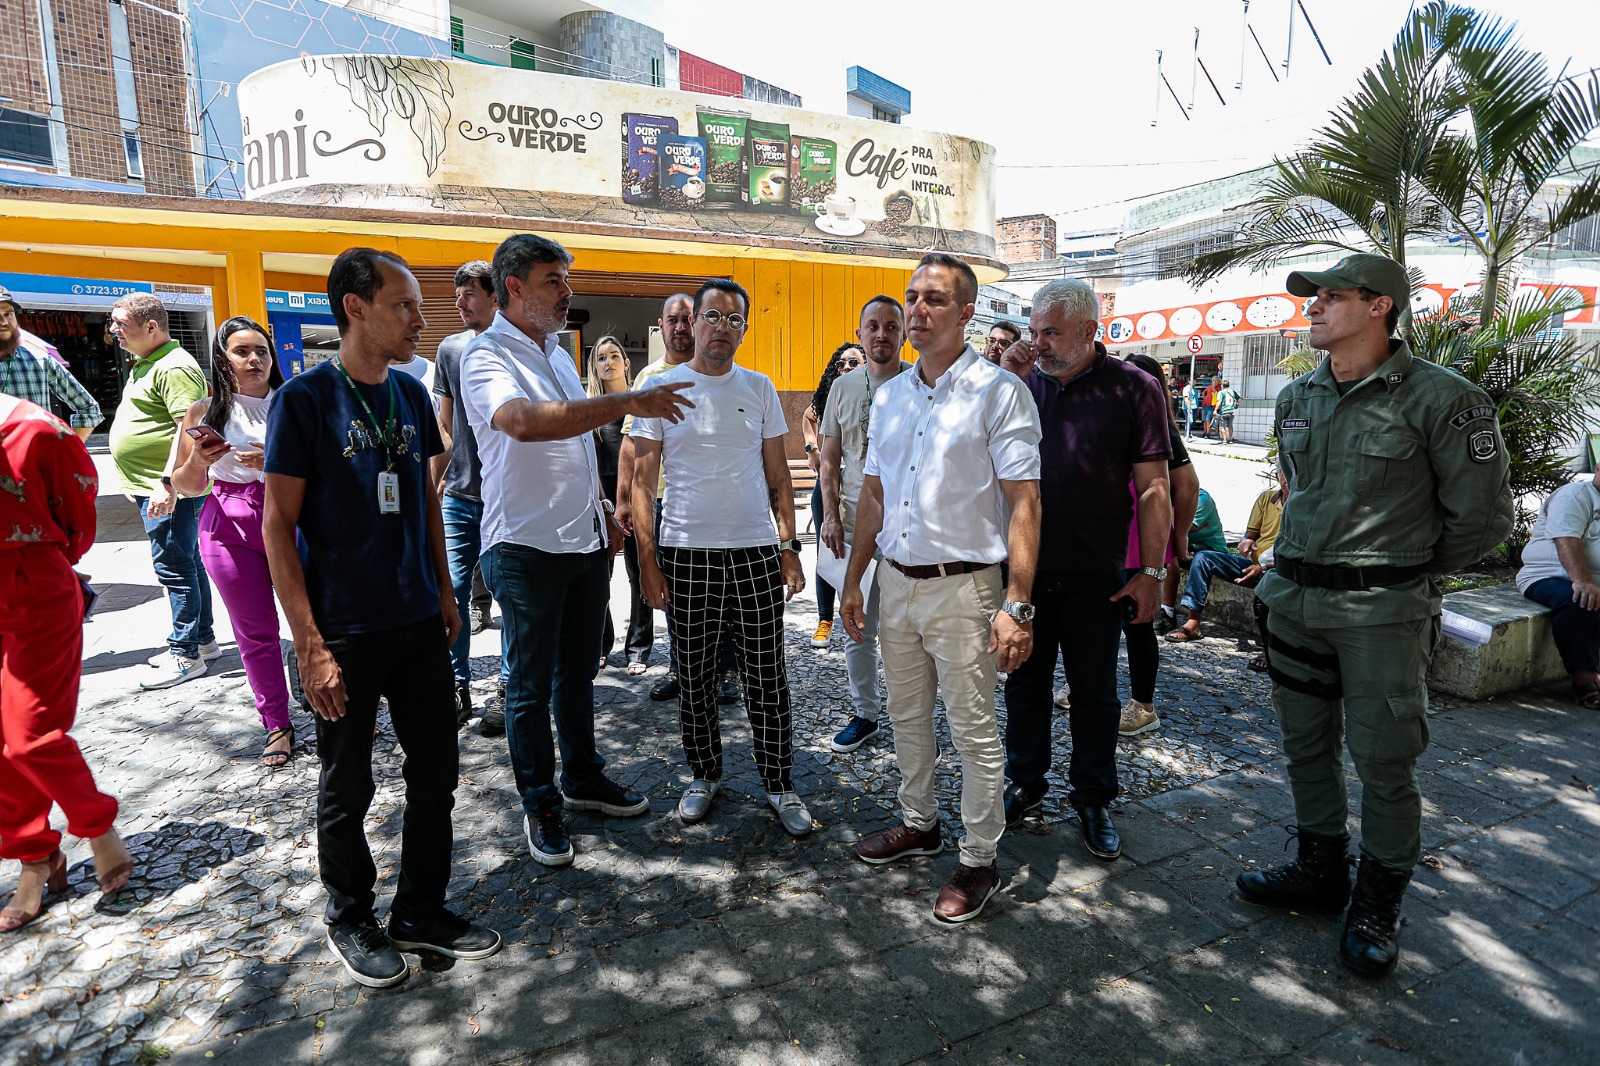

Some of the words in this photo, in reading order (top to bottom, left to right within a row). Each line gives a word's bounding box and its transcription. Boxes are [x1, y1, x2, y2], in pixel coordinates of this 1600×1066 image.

[488, 102, 558, 129] OURO
[705, 123, 735, 138] OURO
[507, 126, 587, 153] VERDE
[712, 134, 746, 147] VERDE
[664, 145, 692, 157] OURO
[755, 143, 778, 154] OURO
[911, 146, 933, 160] PRA
[672, 155, 702, 166] VERDE
[761, 151, 787, 162] VERDE
[845, 138, 908, 189] Café
[911, 163, 938, 177] VIDA
[911, 180, 955, 197] INTEIRA.
[307, 297, 330, 305] xiao
[1192, 338, 1200, 350] E
[1471, 407, 1493, 417] BPM
